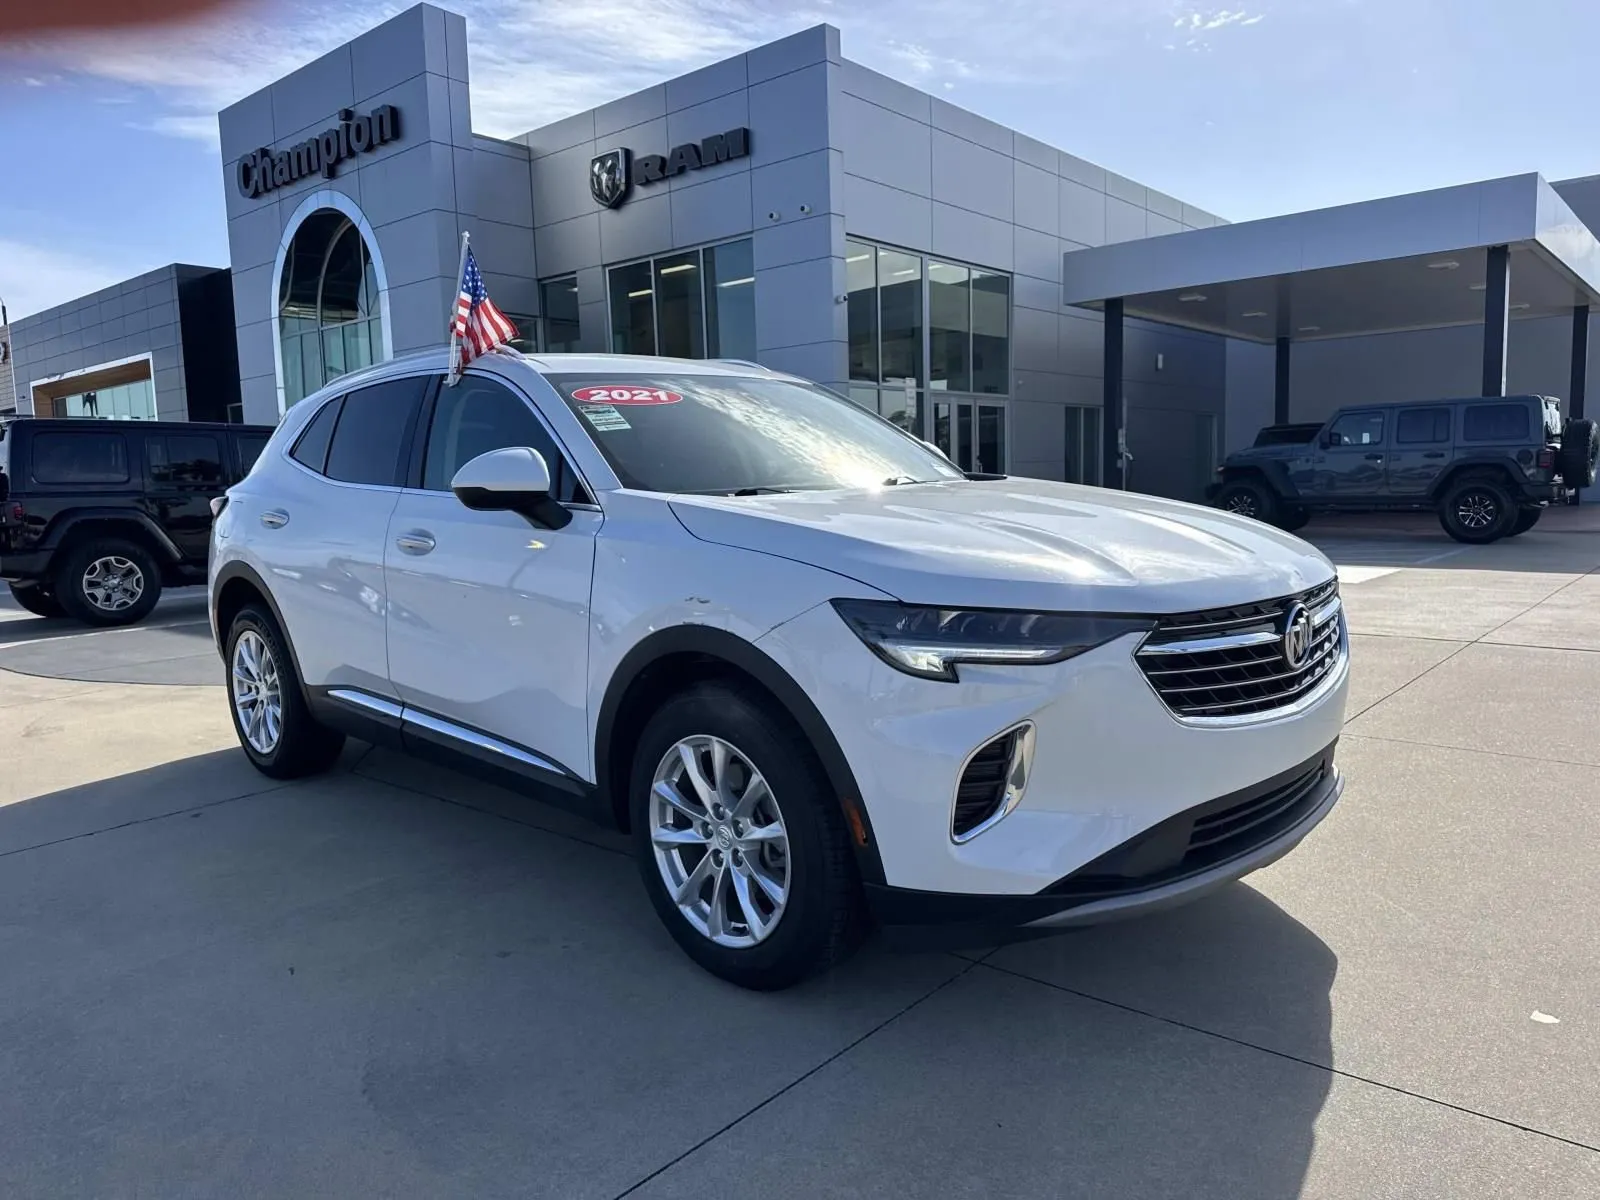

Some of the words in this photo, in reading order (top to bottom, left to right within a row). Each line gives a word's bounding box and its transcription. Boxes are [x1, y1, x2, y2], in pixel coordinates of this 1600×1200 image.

[237, 104, 400, 199] Champion
[632, 127, 750, 186] RAM
[589, 389, 669, 402] 2021
